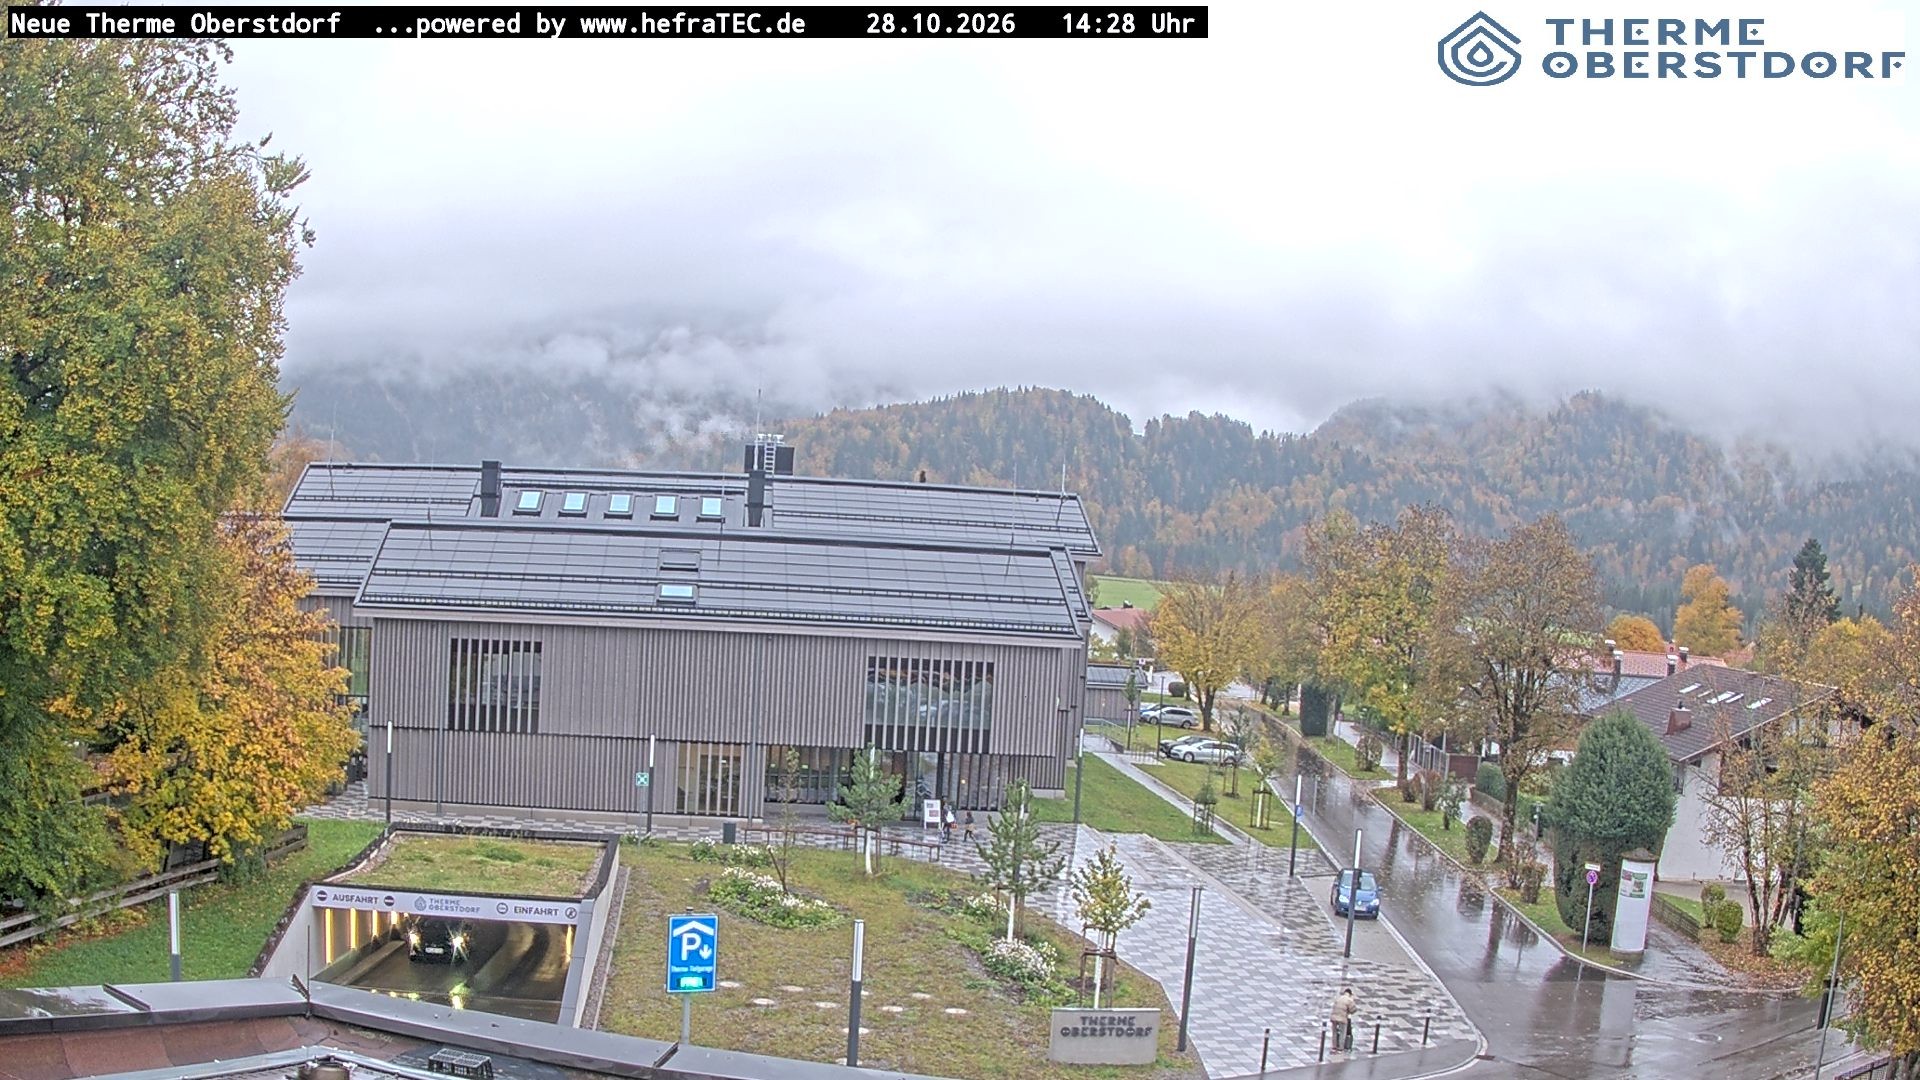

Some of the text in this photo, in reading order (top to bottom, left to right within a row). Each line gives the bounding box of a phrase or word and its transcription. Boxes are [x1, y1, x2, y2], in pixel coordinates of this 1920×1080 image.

[332, 894, 379, 905] AUSFAHRT
[429, 898, 461, 906] THERME
[428, 904, 481, 914] OBERSTDORF
[513, 906, 560, 917] EINFAHRT
[681, 932, 702, 961] P
[1080, 1016, 1136, 1026] THERME
[1060, 1026, 1153, 1038] OBERSTDORF
